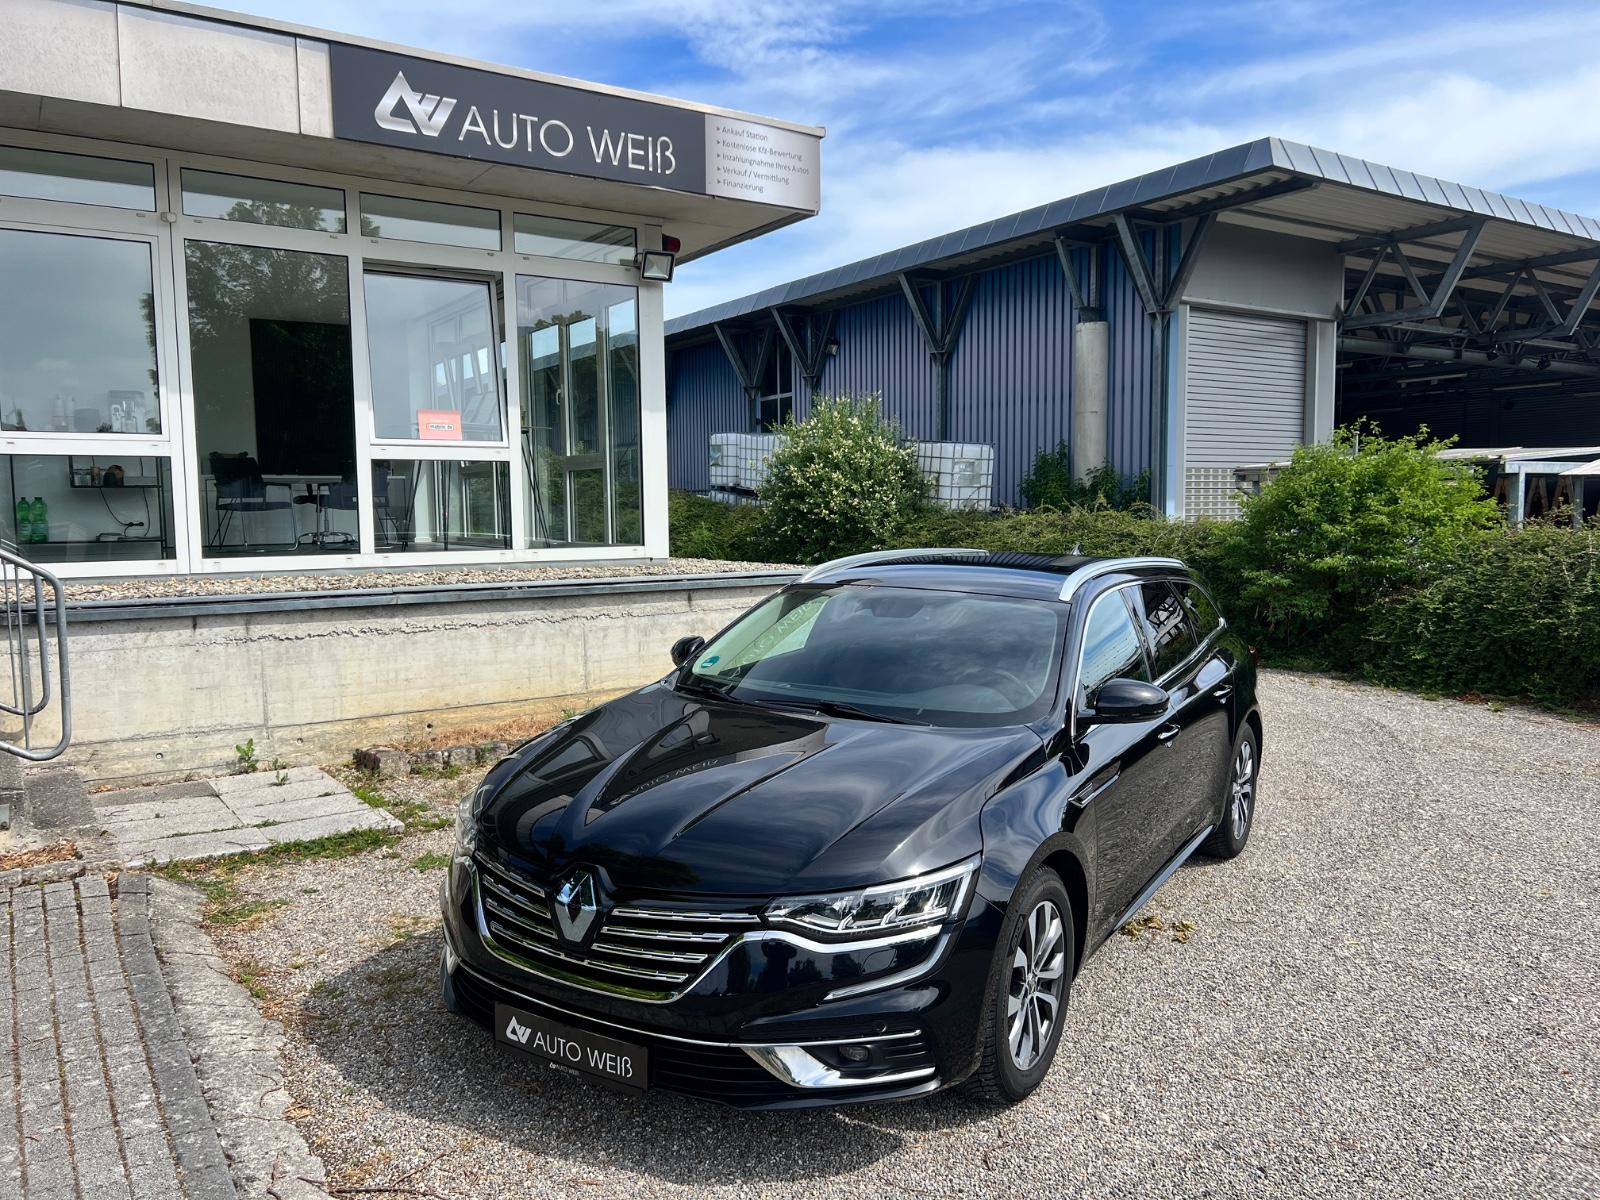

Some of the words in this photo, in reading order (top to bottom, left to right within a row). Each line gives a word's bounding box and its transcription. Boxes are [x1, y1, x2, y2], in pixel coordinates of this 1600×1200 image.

[458, 105, 574, 157] AUTO
[586, 125, 676, 175] WEIß
[722, 126, 745, 137] Ankauf
[746, 131, 768, 141] Station
[722, 140, 757, 153] Kostenlose
[758, 146, 802, 161] Kfz-Bewertung
[722, 153, 775, 168] Inzahlungnahme
[775, 161, 791, 171] Ihres
[722, 166, 747, 177] Verkauf
[753, 171, 789, 185] Vermittlung
[723, 178, 764, 193] Finanzierung
[533, 1031, 582, 1062] AUTO
[587, 1047, 633, 1078] WEIß
